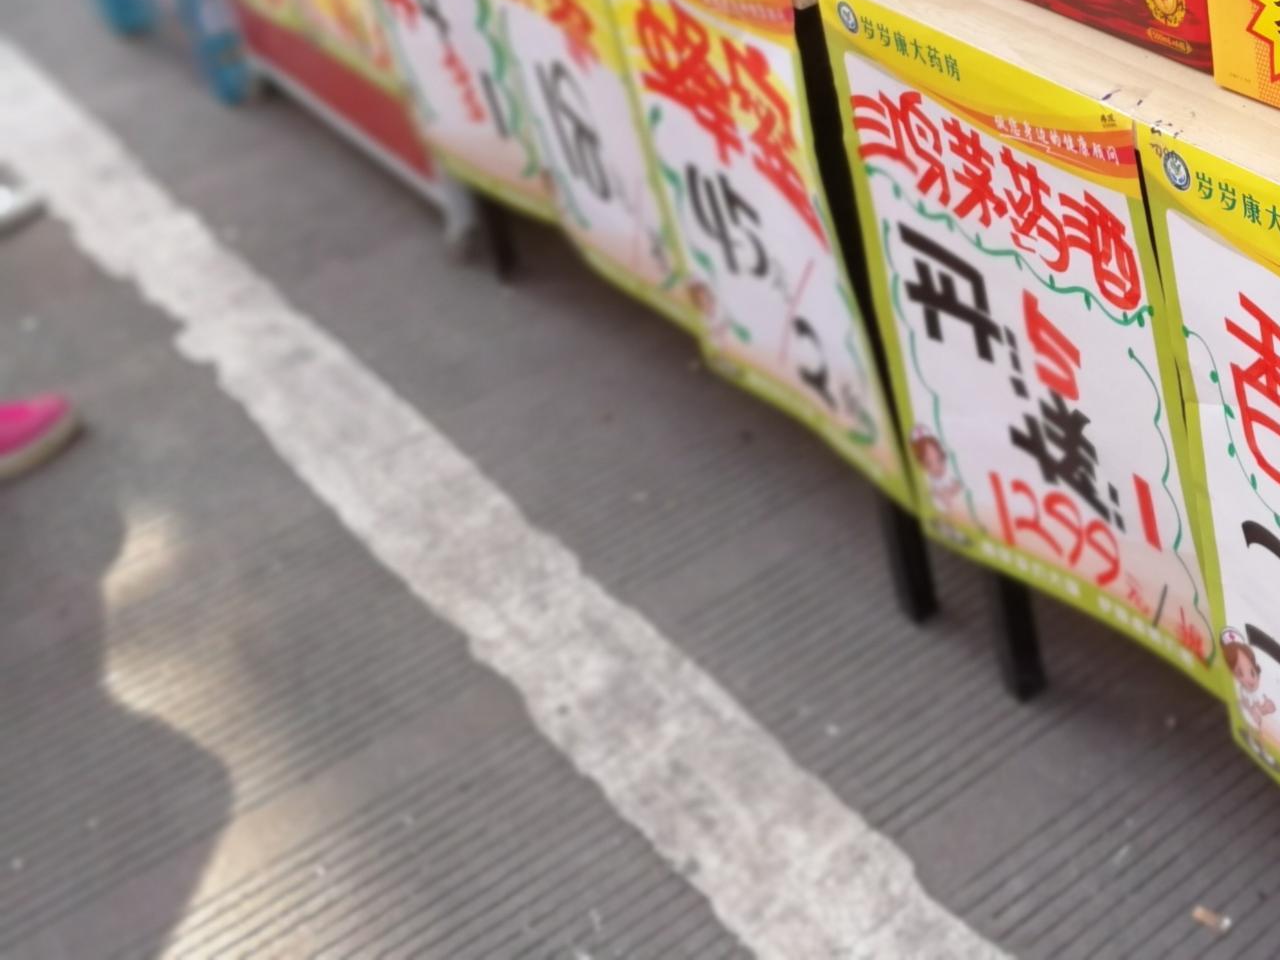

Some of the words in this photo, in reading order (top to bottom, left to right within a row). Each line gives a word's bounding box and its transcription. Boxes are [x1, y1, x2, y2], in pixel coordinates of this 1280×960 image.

[860, 16, 961, 82] 岁岁康大药房
[851, 90, 1142, 311] 鸿茅药酒
[989, 471, 1122, 587] 1299
